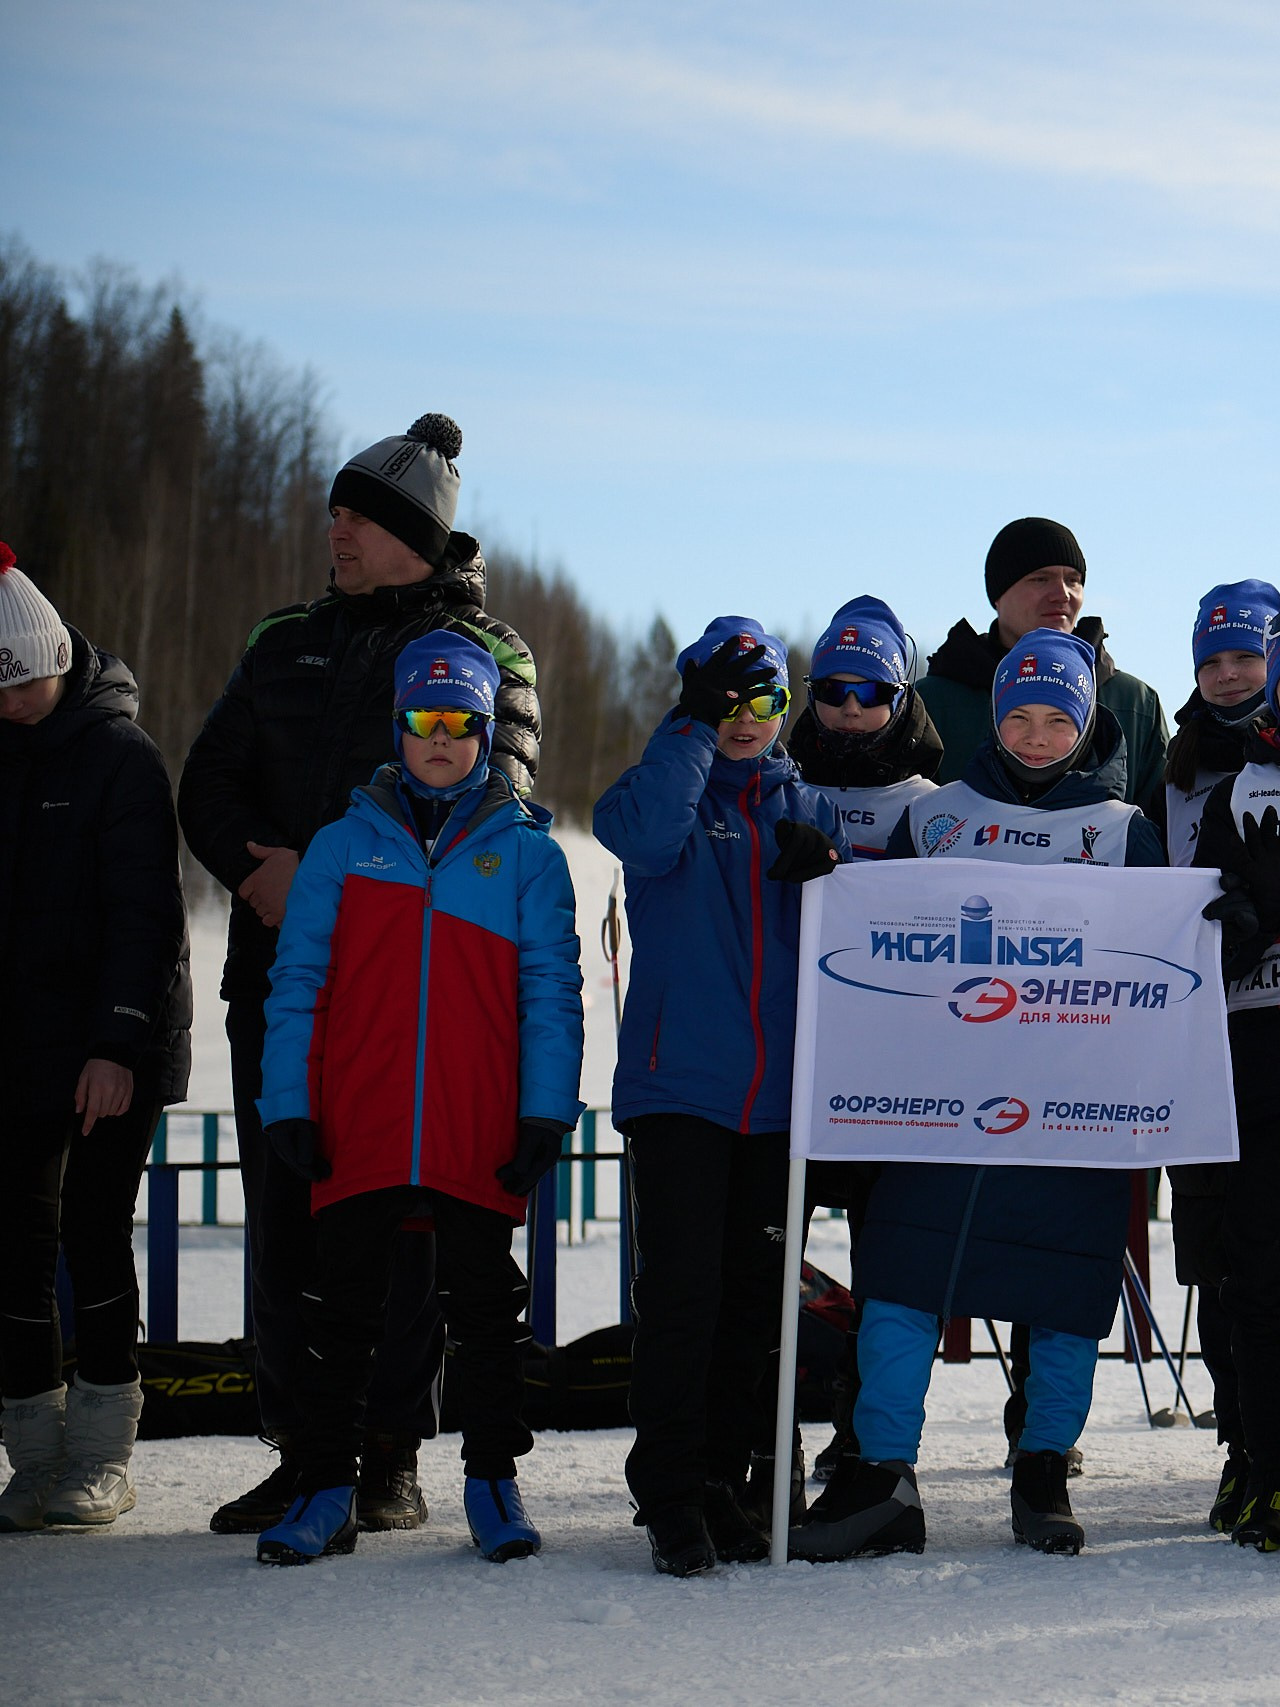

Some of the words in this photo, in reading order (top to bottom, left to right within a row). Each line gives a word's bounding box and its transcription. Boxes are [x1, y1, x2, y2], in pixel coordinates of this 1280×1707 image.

[1208, 622, 1231, 633] ВРЕМЯ
[1232, 621, 1253, 631] БЫТЬ
[862, 646, 881, 660] БЫТЬ
[454, 679, 475, 690] БЫТЬ
[1016, 675, 1041, 683] ВРЕМЯ
[1042, 676, 1064, 686] БЫТЬ
[1004, 829, 1051, 848] ПСБ
[356, 861, 397, 870] NORDSKI
[869, 920, 920, 928] ВЫСОКОВОЛЬТНЫХ
[871, 930, 955, 964] ИНСТА
[998, 935, 1083, 967] INSTA
[1020, 978, 1168, 1009] ЭНЕРГИЯ
[1019, 1012, 1050, 1024] ДЛЯ
[1056, 1013, 1111, 1025] ЖИЗНИ
[829, 1095, 964, 1116] ФОРЭНЕРГО
[1043, 1102, 1170, 1122] FORENERGO
[829, 1117, 903, 1126] производственное
[905, 1120, 958, 1128] объединение
[1042, 1123, 1113, 1132] industrial
[1133, 1127, 1170, 1135] group
